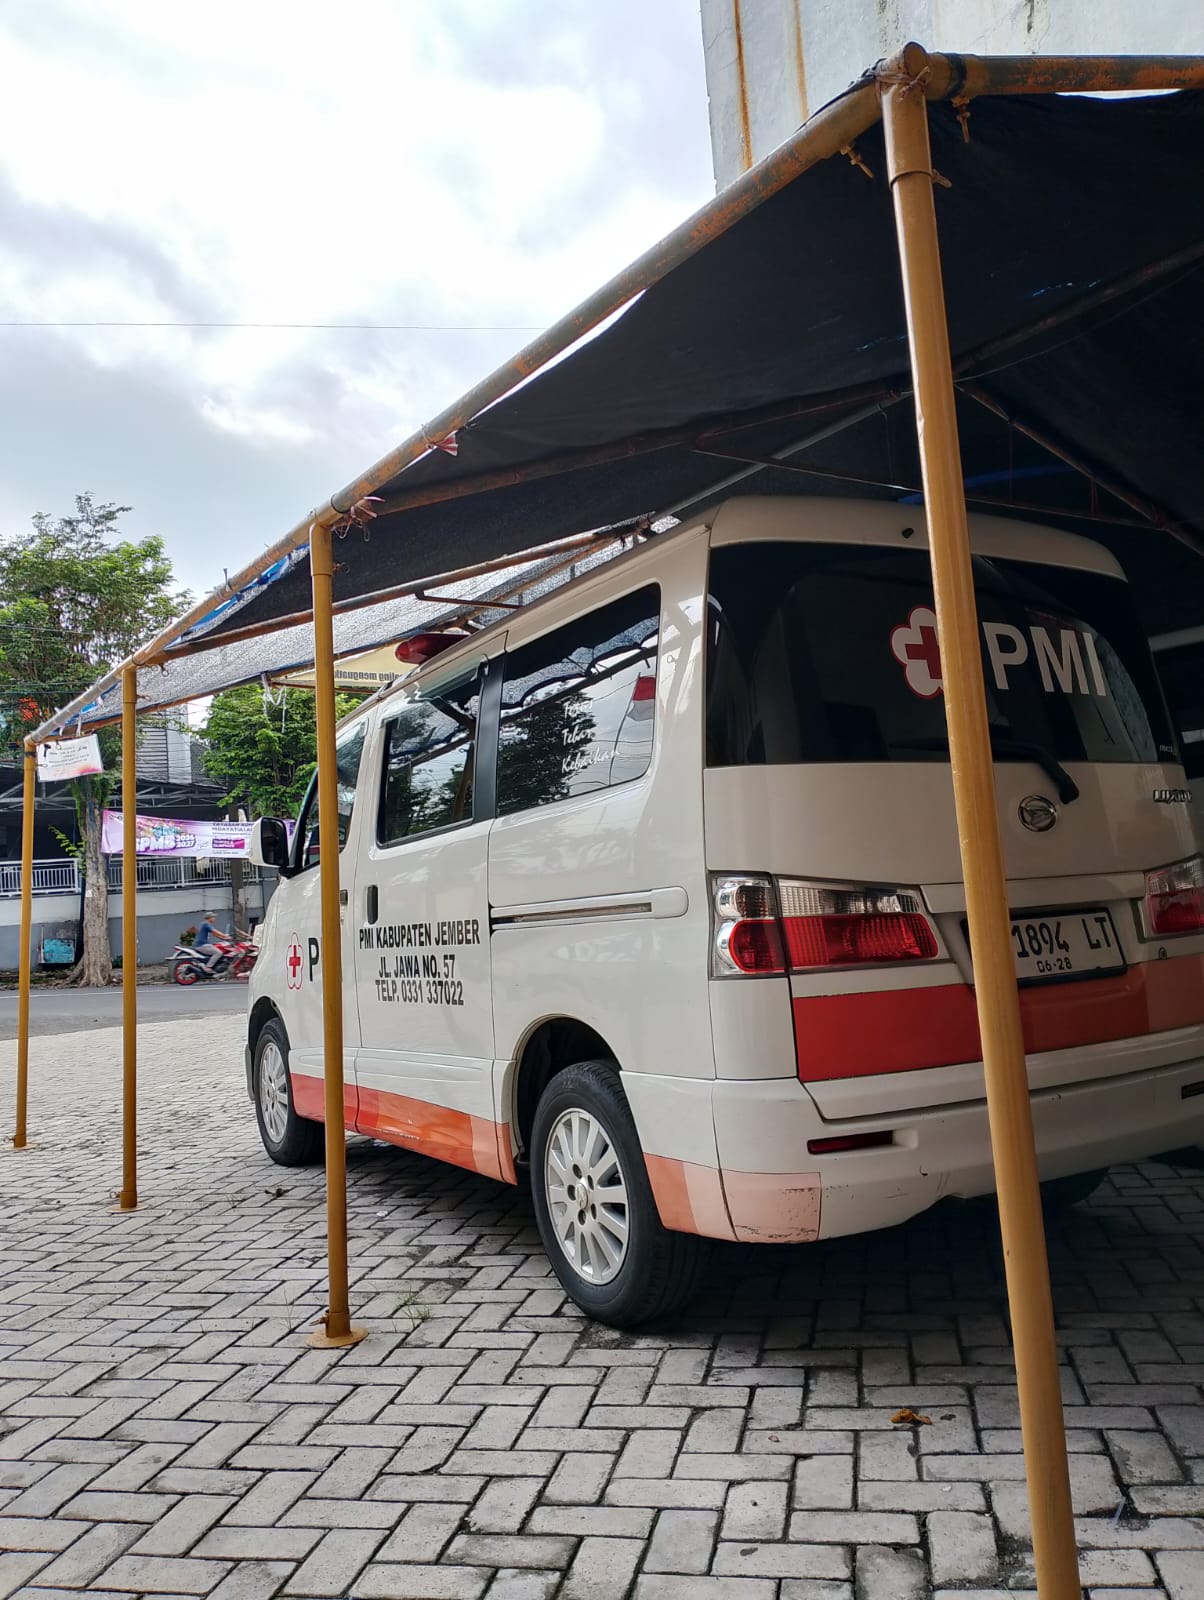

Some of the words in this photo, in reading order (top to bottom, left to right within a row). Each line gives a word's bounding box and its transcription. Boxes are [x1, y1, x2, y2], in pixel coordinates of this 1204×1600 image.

[983, 621, 1107, 697] PMI
[359, 928, 375, 949] PMI
[376, 923, 432, 949] KABUPATEN
[434, 919, 480, 946] JEMBER
[1011, 920, 1070, 958] 1894
[1081, 916, 1111, 949] LT
[378, 956, 391, 978] JL.
[393, 955, 420, 979] JAWA
[422, 954, 440, 979] NO.
[443, 954, 455, 979] 57
[375, 979, 400, 1002] TELP.
[402, 980, 424, 1003] 0331
[426, 980, 464, 1006] 337022
